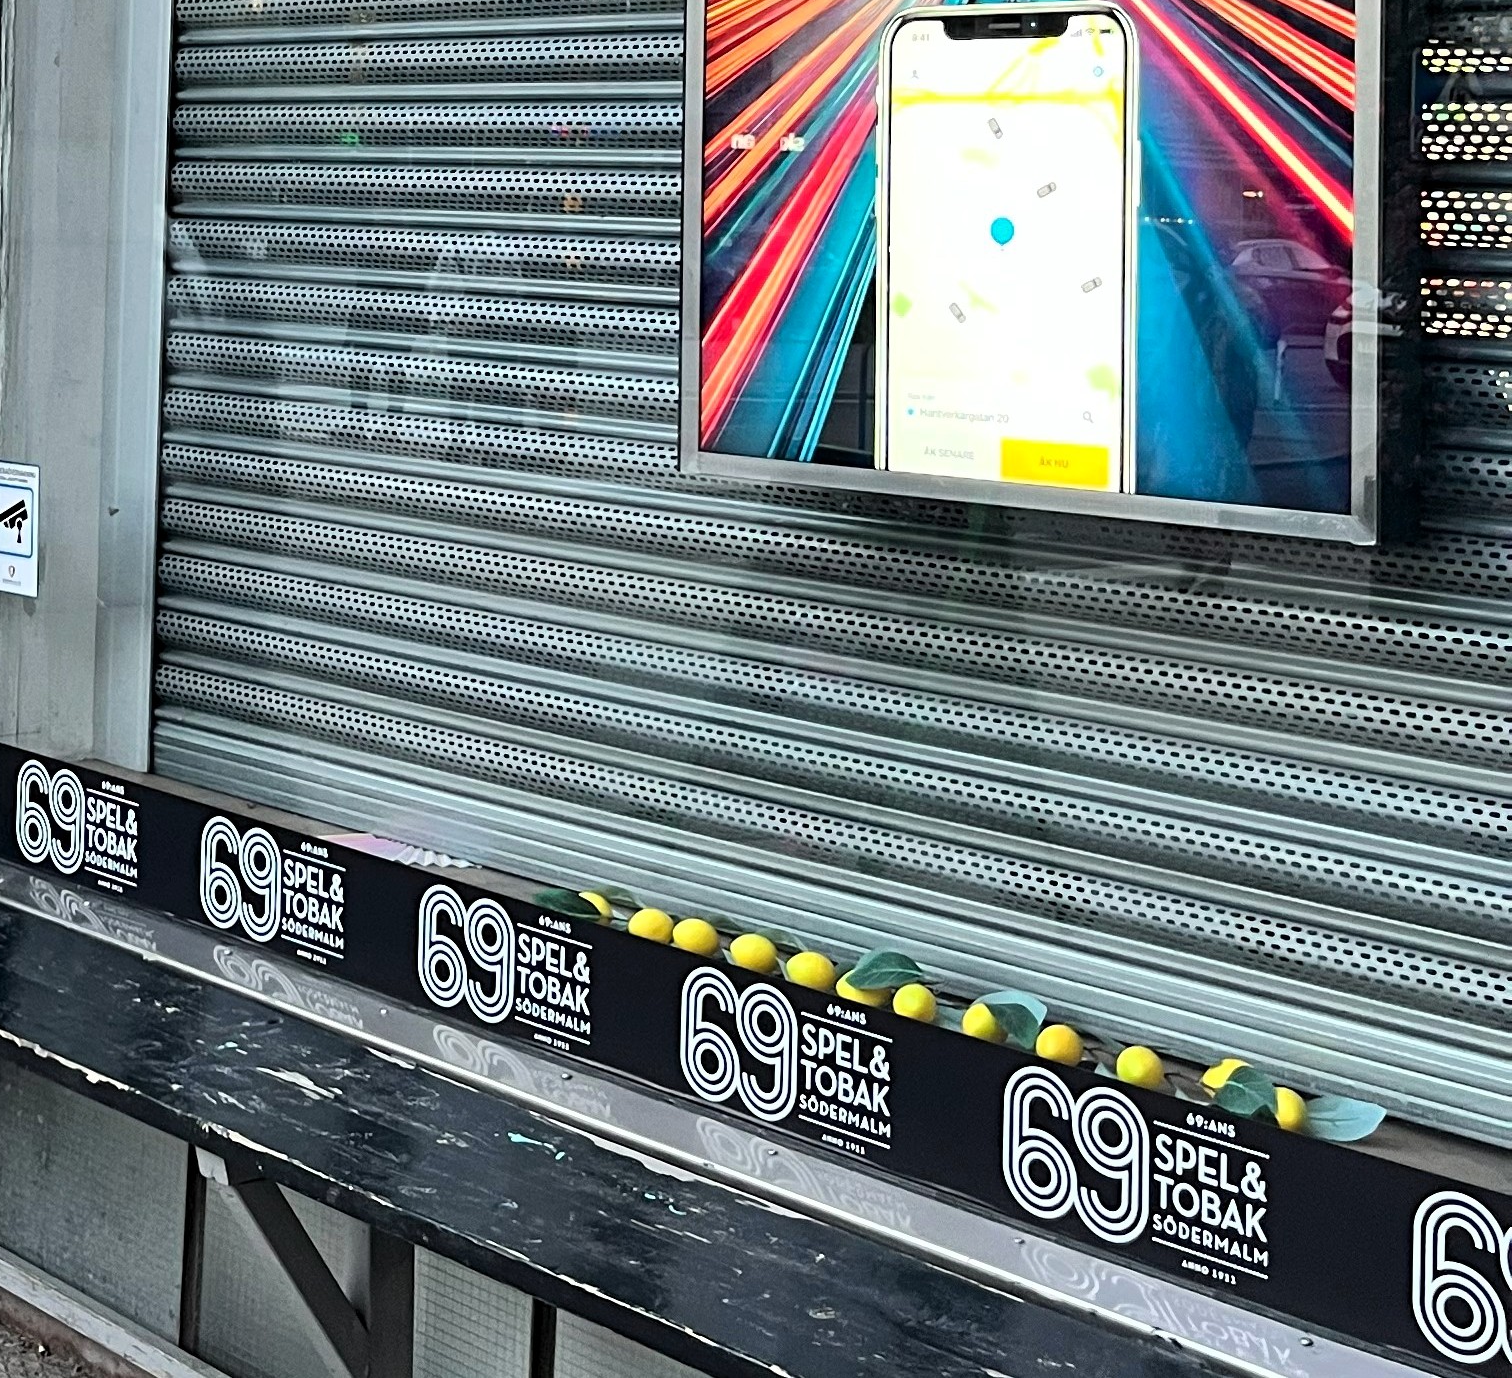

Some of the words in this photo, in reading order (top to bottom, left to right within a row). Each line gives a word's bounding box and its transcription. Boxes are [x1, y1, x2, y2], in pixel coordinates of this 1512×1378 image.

[16, 759, 86, 874] 69
[85, 824, 138, 863] TOBAK
[200, 815, 281, 943] 69
[281, 917, 344, 950] SÖDERMALM
[282, 888, 344, 933] TOBAK
[417, 884, 516, 1024] 69
[515, 997, 591, 1035] SÖDERMALM
[516, 966, 590, 1016] TOBAK
[680, 966, 798, 1122] 69
[798, 1093, 891, 1138] SÖDERMALM
[800, 1058, 890, 1117] TOBAK
[1002, 1065, 1150, 1244] 69
[1153, 1173, 1268, 1243] TOBAK
[1152, 1214, 1269, 1268] SÖDERMALM
[1412, 1190, 1512, 1365] 6
